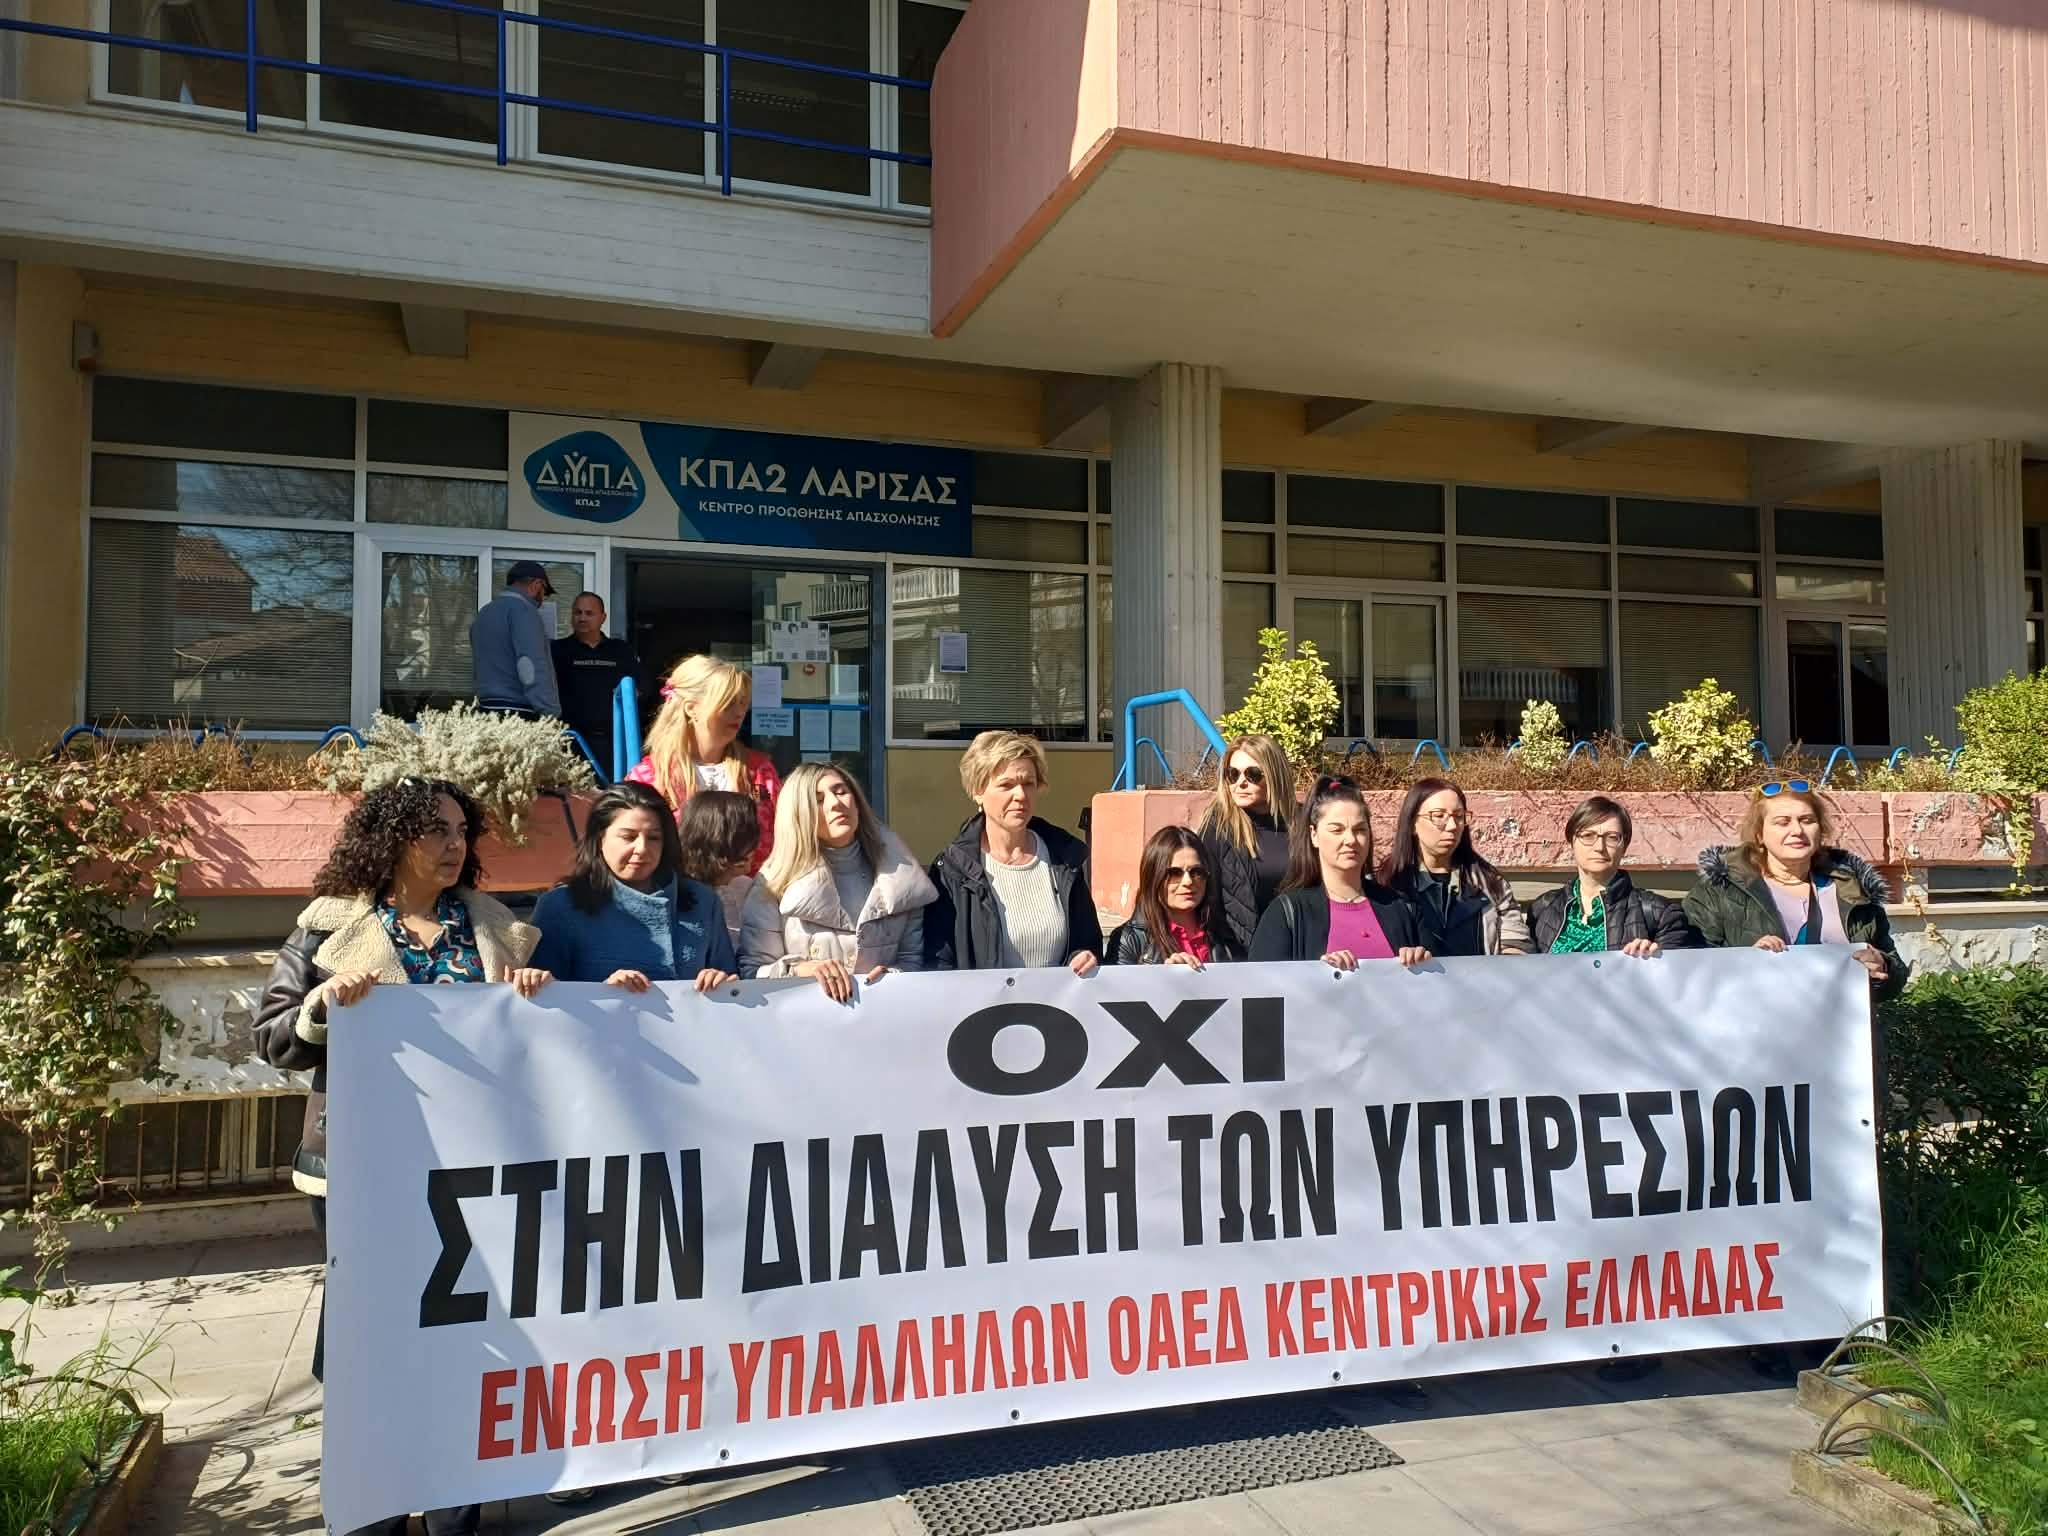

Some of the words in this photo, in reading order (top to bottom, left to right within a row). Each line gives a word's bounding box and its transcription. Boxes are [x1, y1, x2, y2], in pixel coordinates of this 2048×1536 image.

[680, 457, 787, 493] ΚΠΑ2
[800, 467, 957, 504] ΛΑΡΙΣΑΣ
[699, 501, 754, 515] ΚΕΝΤΡΟ
[758, 505, 843, 521] ΠΡΟΩΘΗΣΗΣ
[846, 512, 941, 527] ΑΠΑΣΧΟΛΗΣΗΣ
[947, 997, 1286, 1096] ΟΧΙ
[419, 1149, 704, 1328] ΣΤΗΝ
[742, 1117, 1139, 1294] ΔΙΑΛΥΣΗ
[1168, 1107, 1337, 1247] ΤΩΝ
[1364, 1084, 1812, 1231] ΥΠΗΡΕΣΙΩΝ
[477, 1346, 704, 1460] ΕΝΩΣΗ
[729, 1301, 1089, 1424] ΥΠΑΛΛΗΛΩΝ
[1108, 1287, 1249, 1376] ΟΑΕΔ
[1266, 1263, 1548, 1358] ΚΕΝΤΡΙΚΗΣ
[1566, 1242, 1784, 1329] ΕΛΛΑΔΑΣ
